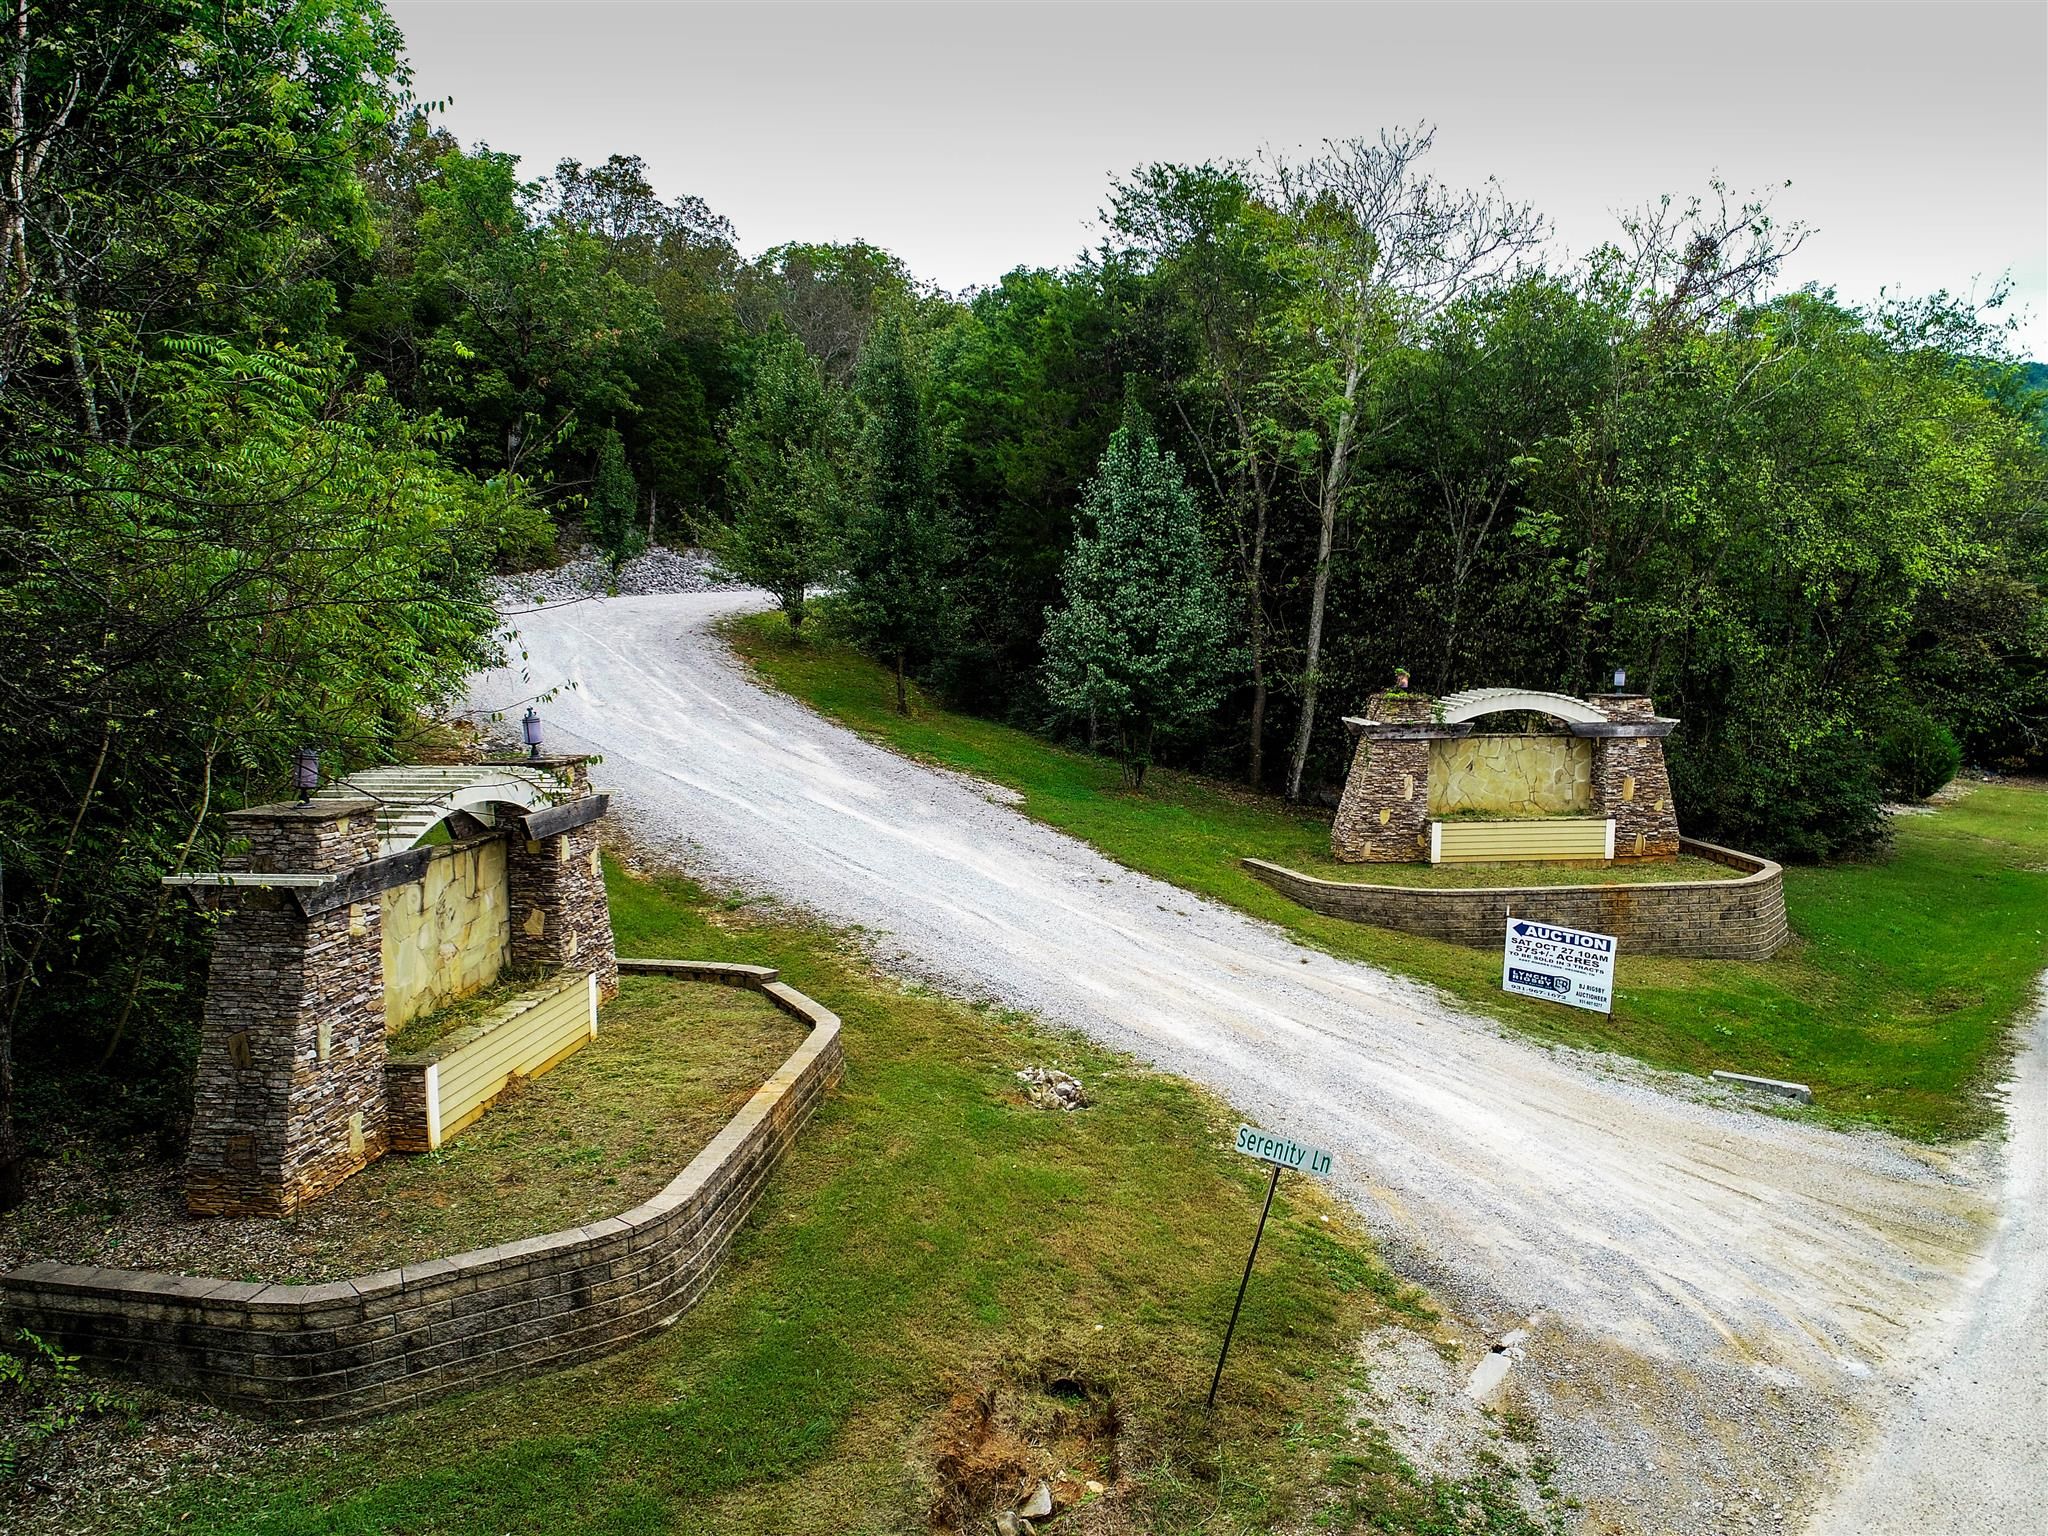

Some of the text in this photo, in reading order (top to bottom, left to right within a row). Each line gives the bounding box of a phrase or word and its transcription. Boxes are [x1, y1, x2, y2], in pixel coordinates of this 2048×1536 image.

[1511, 937, 1608, 962] SAT OCT 27 10AM
[1525, 926, 1608, 951] AUCTION
[1515, 945, 1554, 957] 575+/-
[1556, 954, 1600, 968] ACRES
[1534, 955, 1554, 963] SOLD
[1573, 963, 1604, 974] TRACTS
[1576, 991, 1607, 1002] AUCTIONEER
[1237, 1128, 1331, 1173] Serenity Ln
